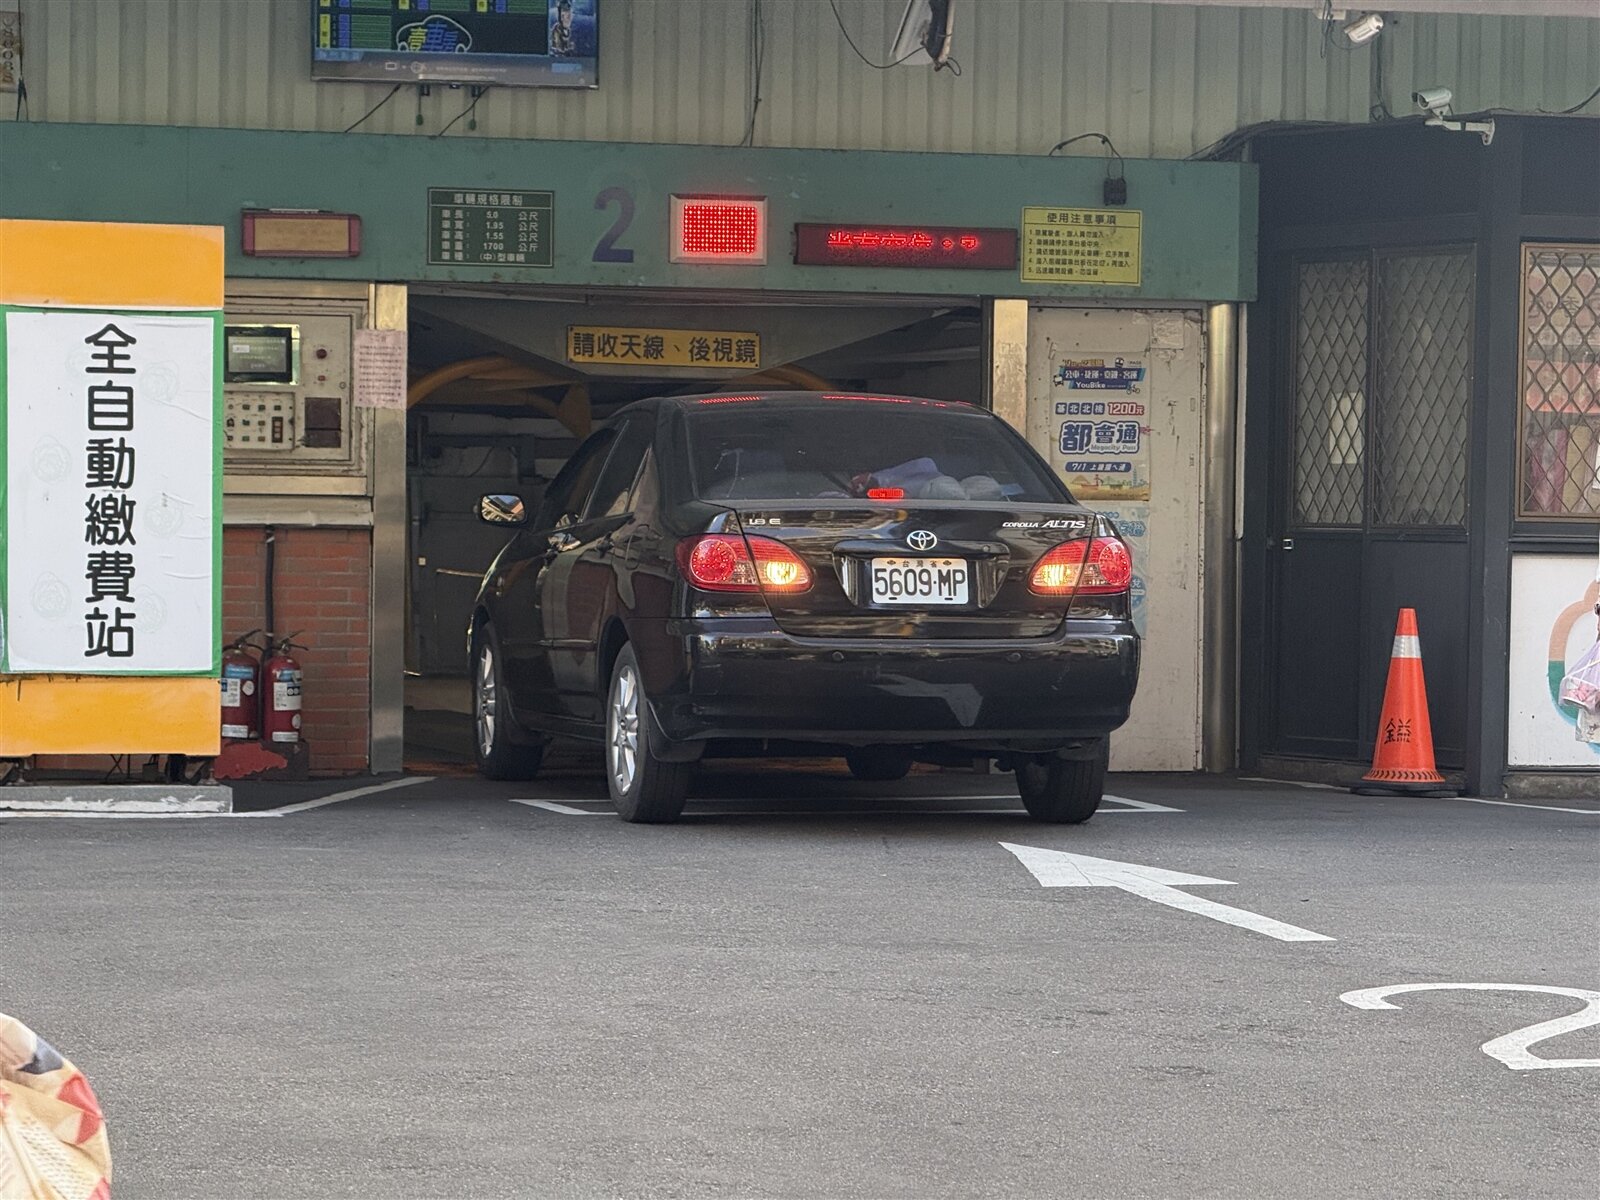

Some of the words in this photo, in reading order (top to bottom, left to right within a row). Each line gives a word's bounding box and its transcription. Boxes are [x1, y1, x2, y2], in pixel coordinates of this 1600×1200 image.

[518, 211, 538, 221] 公尺
[1047, 212, 1117, 225] 使用注意事項
[518, 222, 538, 231] 公尺
[592, 187, 634, 263] 2
[518, 232, 538, 242] 公尺
[483, 242, 504, 250] 1700
[518, 243, 538, 252] 公斤
[573, 332, 757, 364] 請收天線、後視鏡
[1076, 381, 1106, 389] YouBike
[1107, 402, 1145, 415] 1200元
[1061, 423, 1138, 452] 都會通
[84, 323, 137, 658] 全自動繳費站
[1042, 519, 1086, 529] ALTIS
[1339, 982, 1600, 1070] 2
